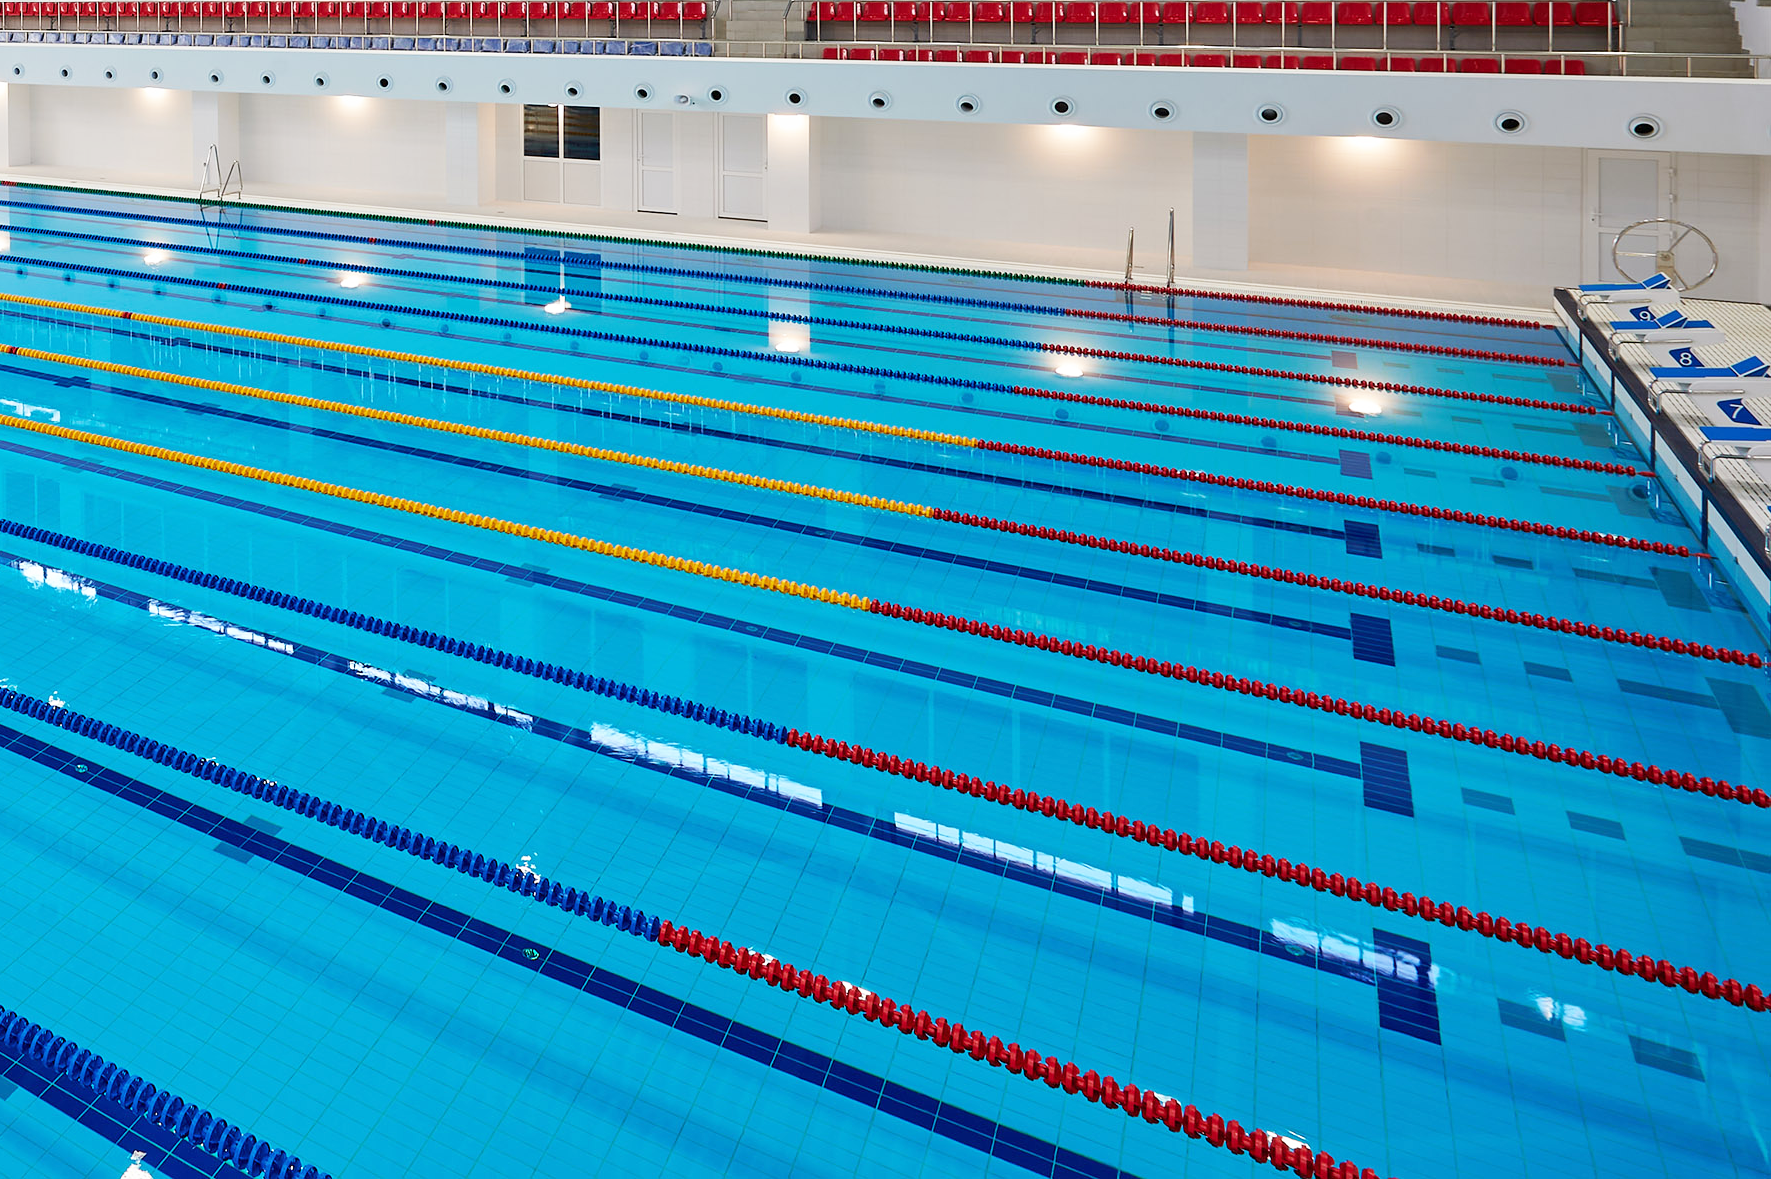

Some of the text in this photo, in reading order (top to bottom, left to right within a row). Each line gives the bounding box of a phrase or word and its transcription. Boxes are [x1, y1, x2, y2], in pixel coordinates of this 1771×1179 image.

[1639, 310, 1652, 322] 9
[1679, 352, 1693, 366] 8
[1729, 403, 1744, 419] 7
